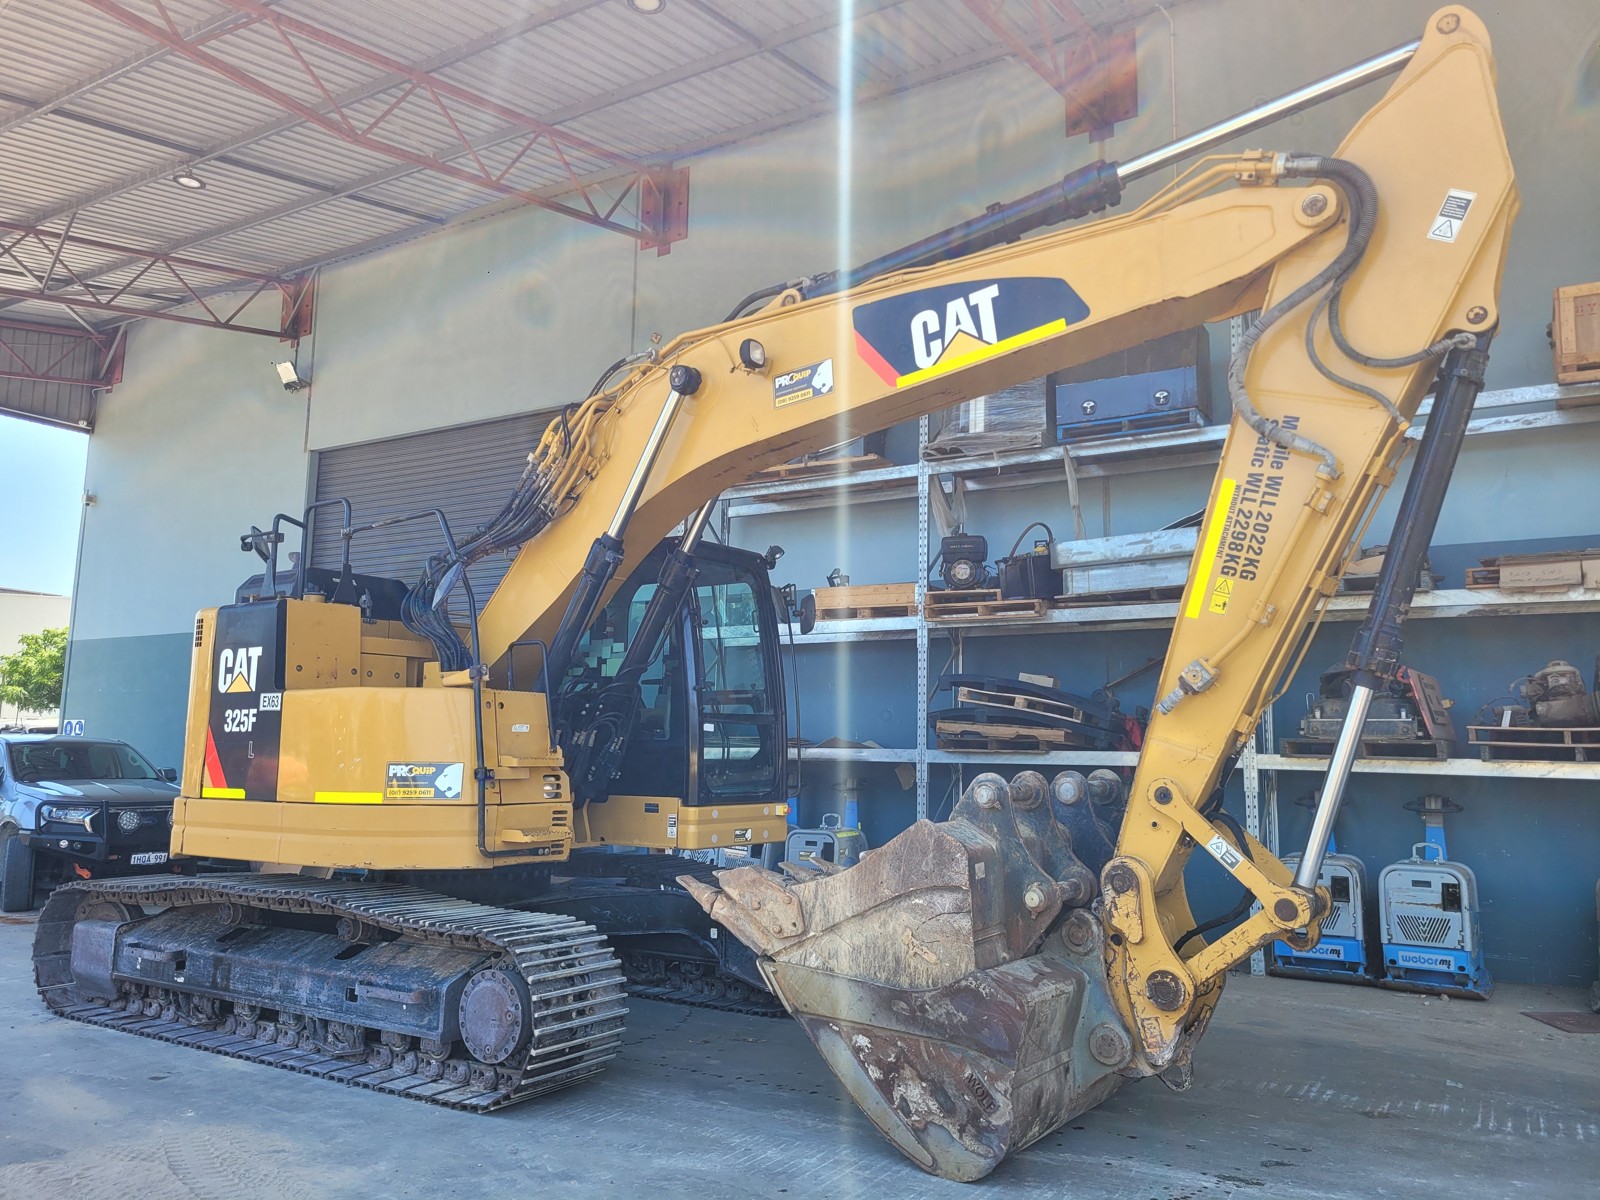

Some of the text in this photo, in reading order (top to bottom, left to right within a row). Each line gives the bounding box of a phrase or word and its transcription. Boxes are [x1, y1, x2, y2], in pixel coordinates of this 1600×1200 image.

[911, 283, 999, 369] CAT
[1270, 415, 1300, 470] Mile
[1240, 472, 1265, 505] WLL
[1259, 476, 1284, 508] WLL
[1216, 484, 1242, 558] WITHOUT ATTACHMENT
[218, 646, 263, 694] CAT
[262, 695, 280, 708] EX63
[224, 708, 257, 733] 325F
[248, 741, 255, 758] L
